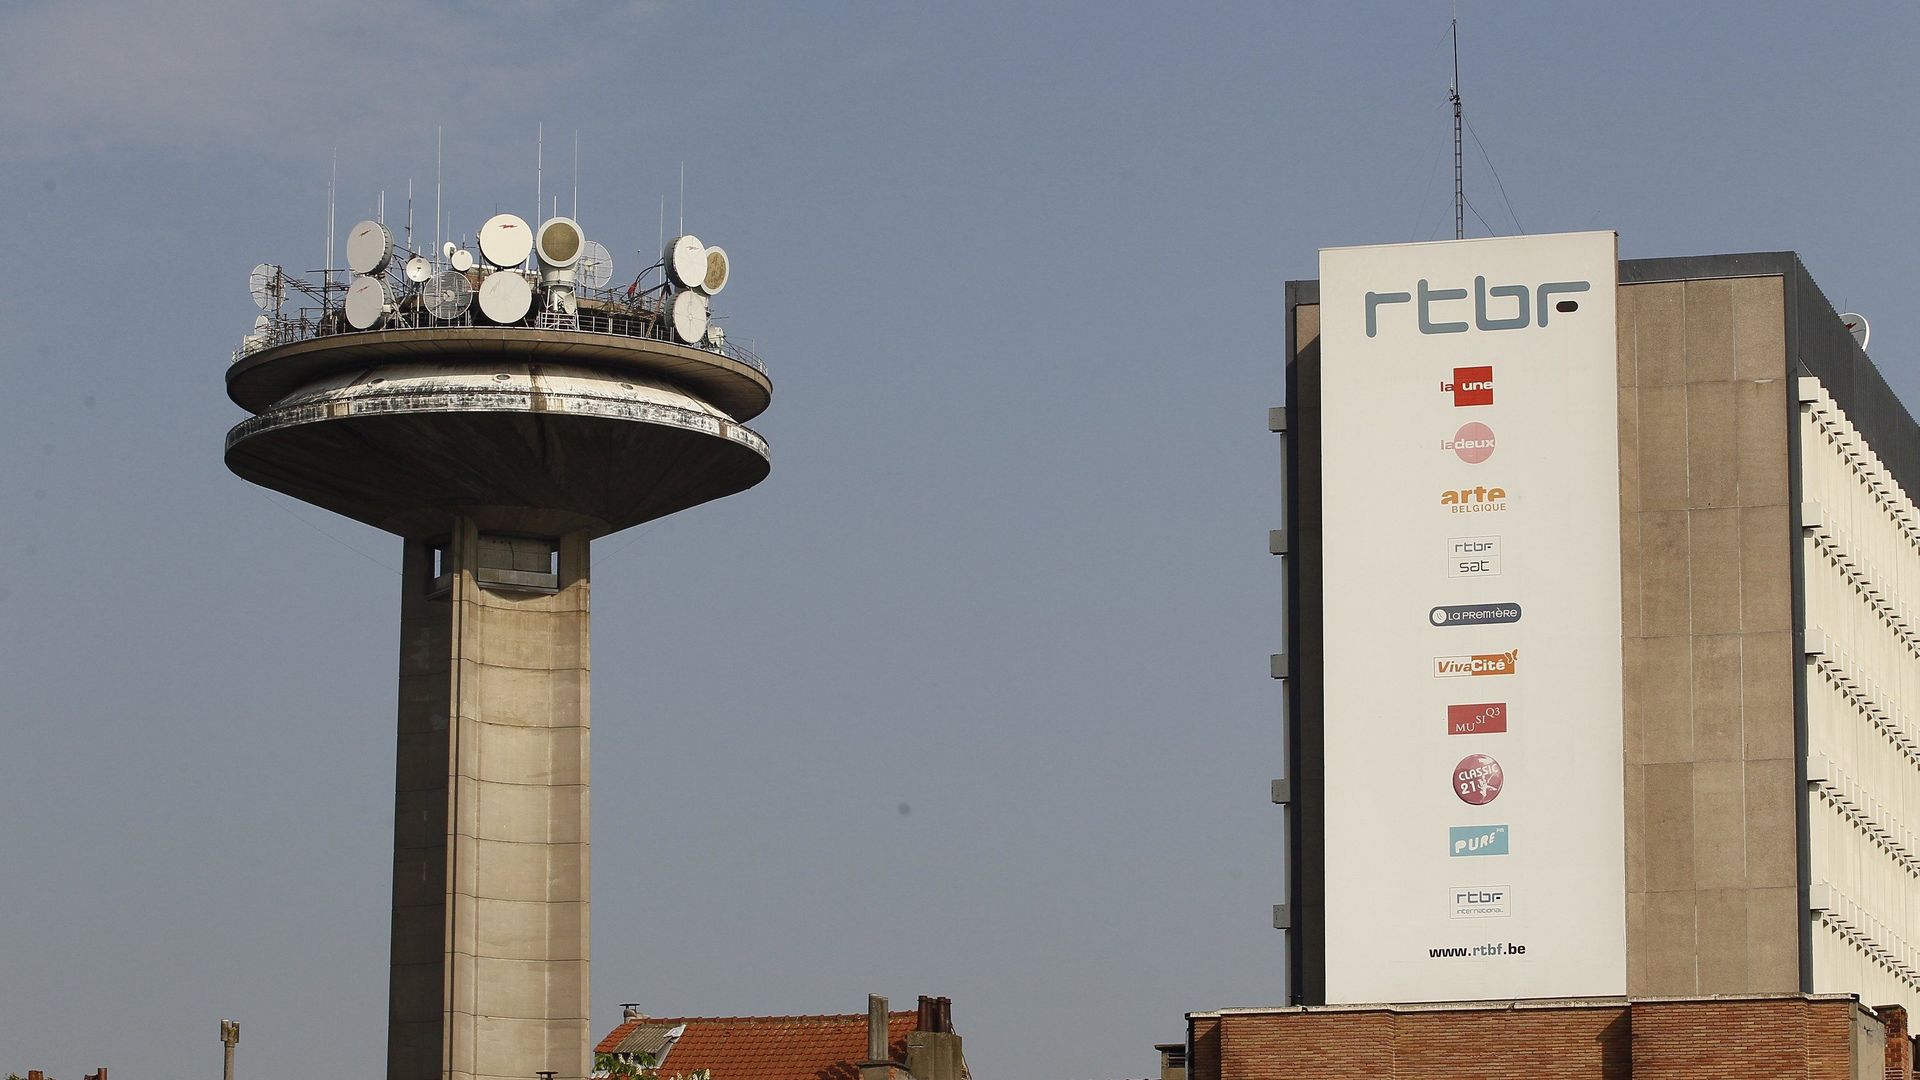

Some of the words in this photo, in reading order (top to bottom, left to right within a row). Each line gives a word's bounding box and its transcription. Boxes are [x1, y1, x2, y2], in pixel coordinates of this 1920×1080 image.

[1365, 275, 1590, 337] rtbf
[1440, 381, 1454, 391] la
[1462, 381, 1493, 391] une
[1441, 486, 1505, 504] arte
[1451, 503, 1506, 513] BELGIQUE
[1459, 560, 1489, 572] sat
[1458, 763, 1499, 781] CLASSIC
[1460, 780, 1476, 795] 21
[1455, 832, 1495, 854] PURE
[1429, 942, 1526, 958] www.rtbf.be
